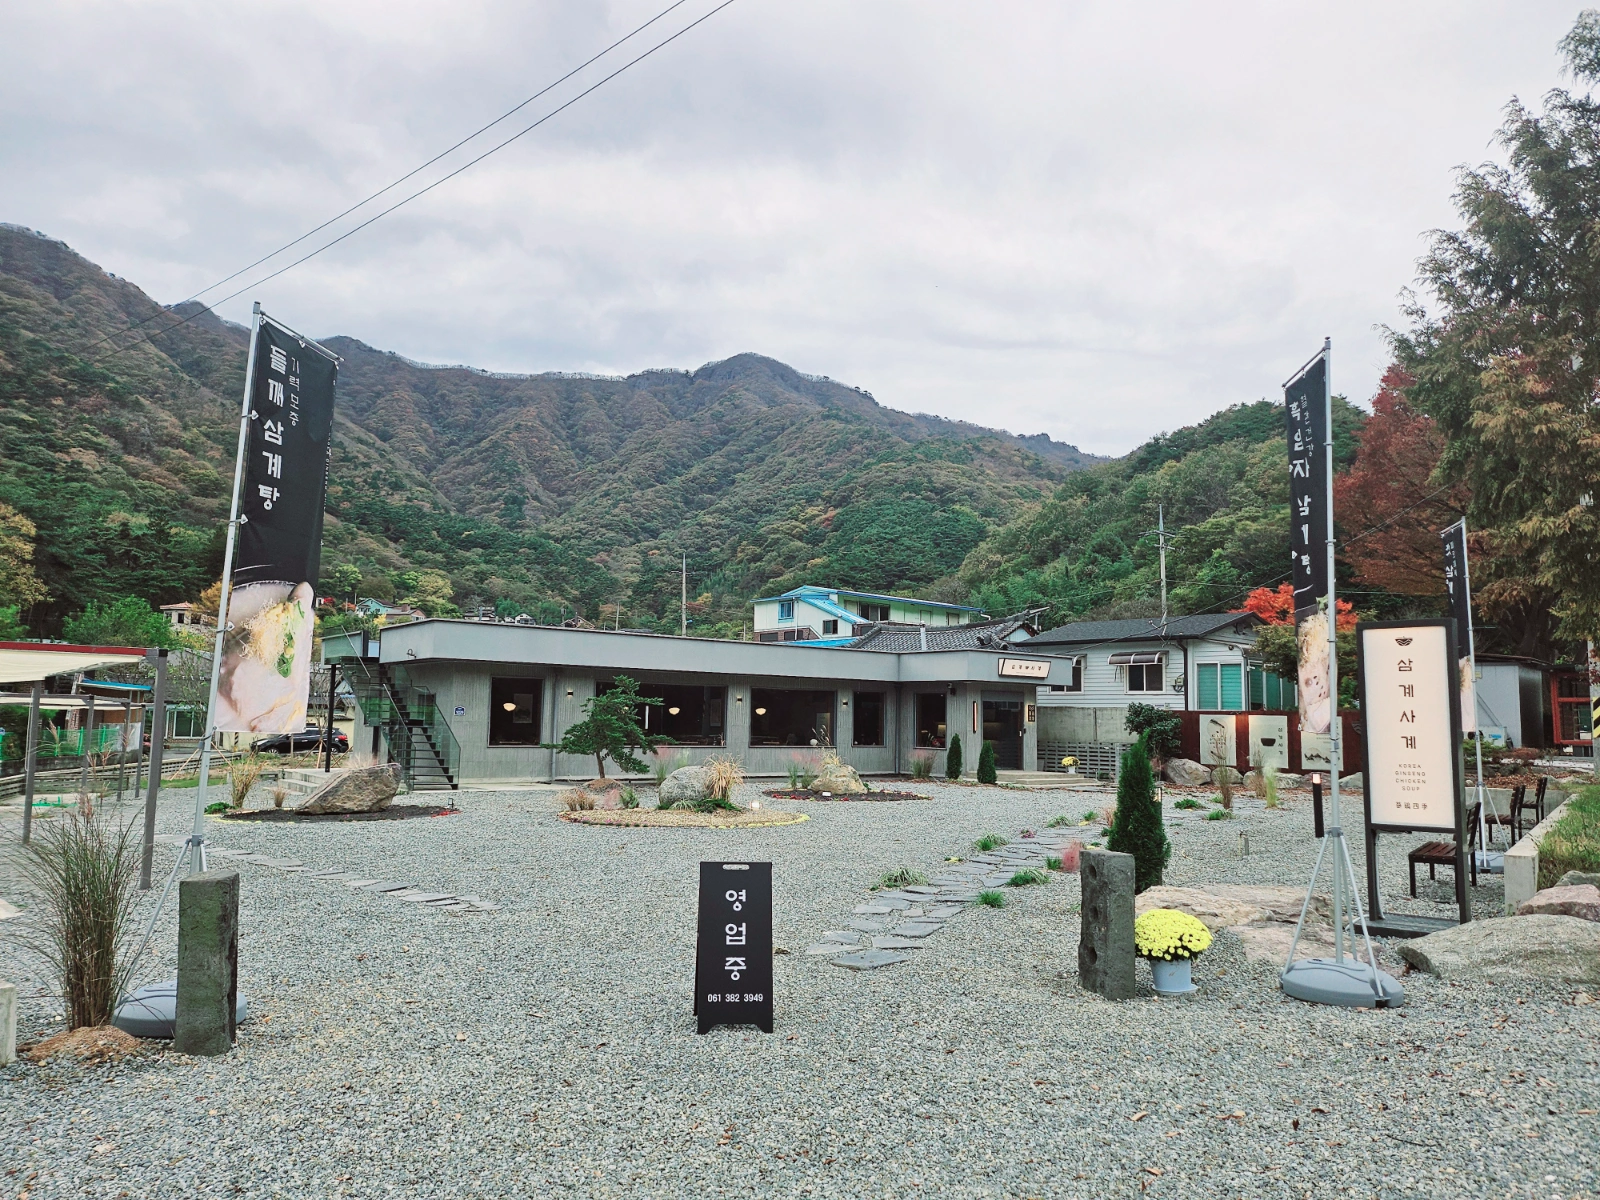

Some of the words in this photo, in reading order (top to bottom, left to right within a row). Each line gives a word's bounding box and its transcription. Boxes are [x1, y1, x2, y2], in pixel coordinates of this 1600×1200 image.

[1397, 658, 1416, 750] 삼계사계
[724, 889, 747, 981] 영업중
[707, 993, 721, 1003] 061
[725, 993, 740, 1003] 382
[743, 993, 764, 1003] 3949
